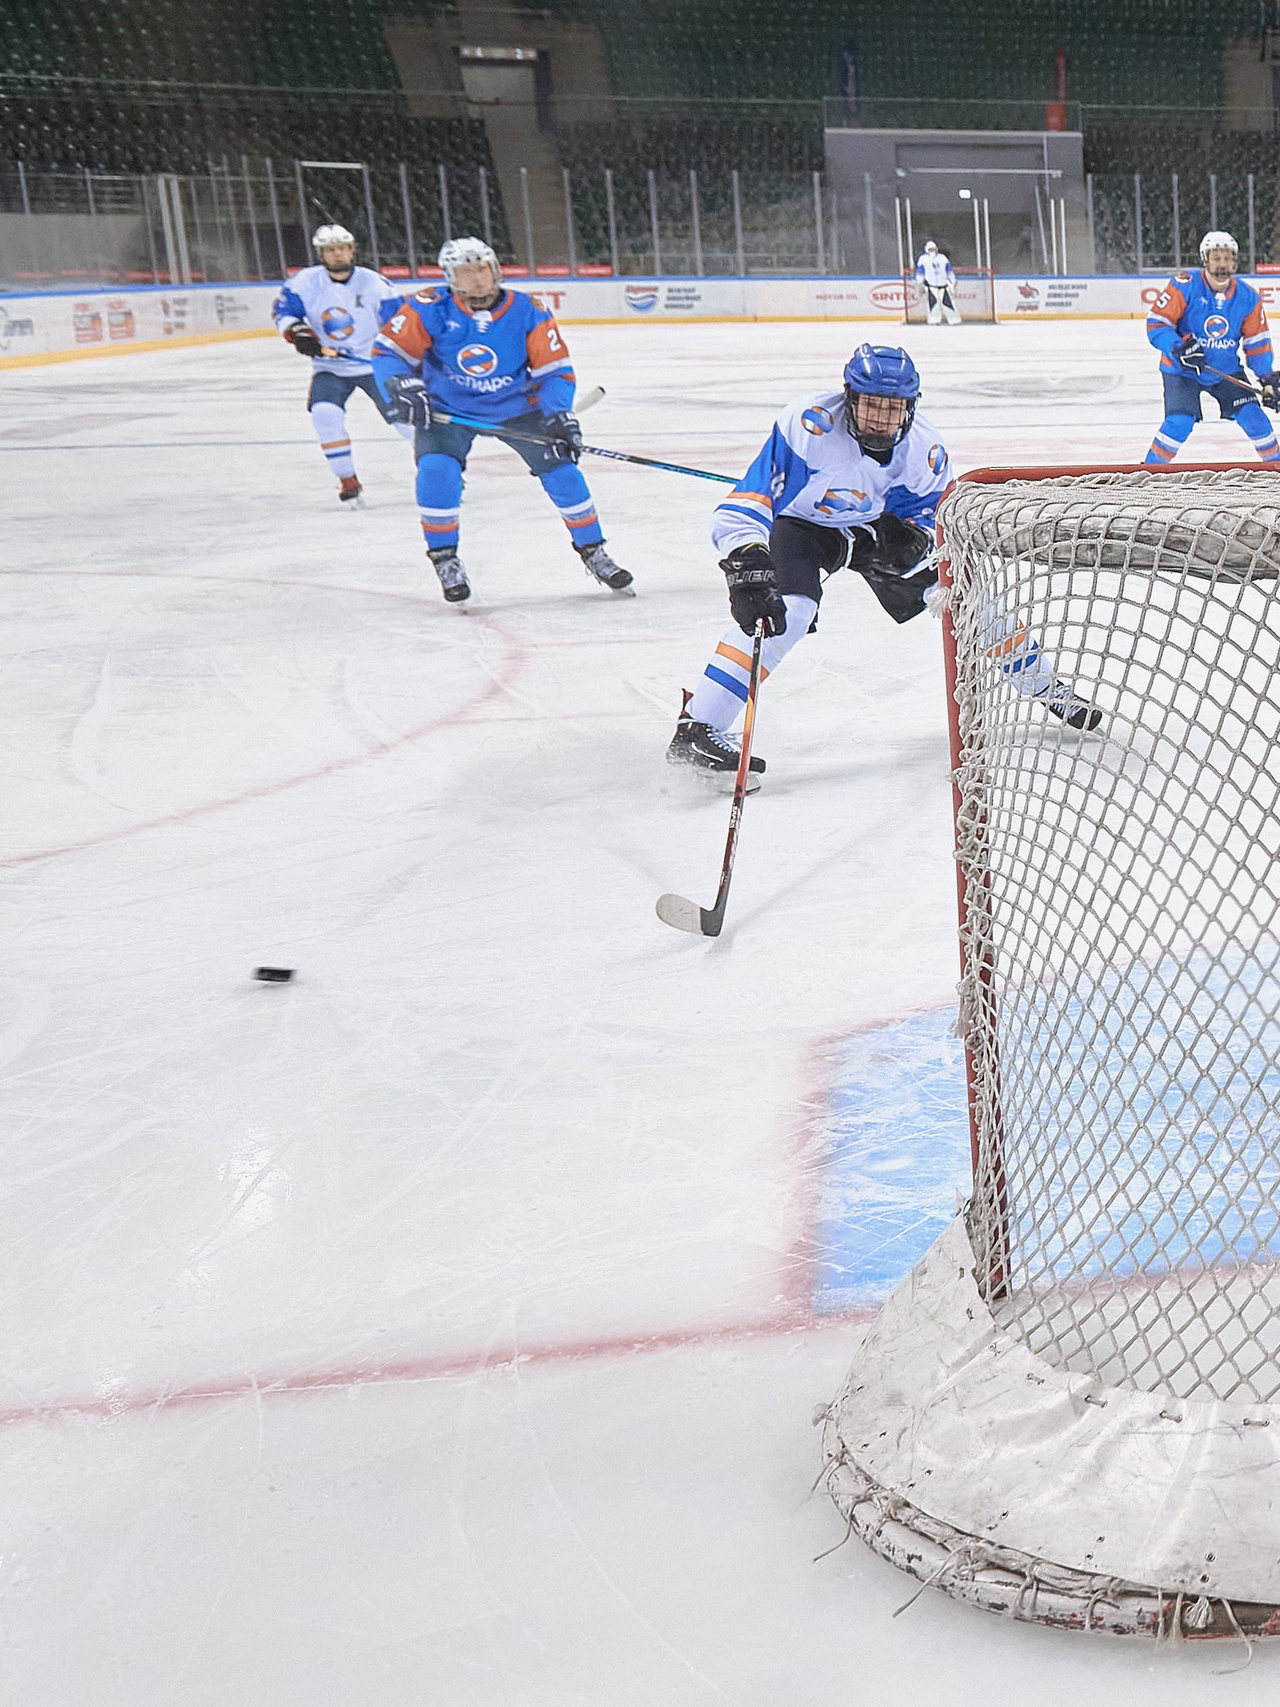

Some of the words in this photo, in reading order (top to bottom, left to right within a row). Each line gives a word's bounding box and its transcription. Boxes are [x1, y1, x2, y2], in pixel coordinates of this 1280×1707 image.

[1156, 292, 1172, 309] 5
[390, 314, 407, 335] 4
[547, 329, 561, 352] 2
